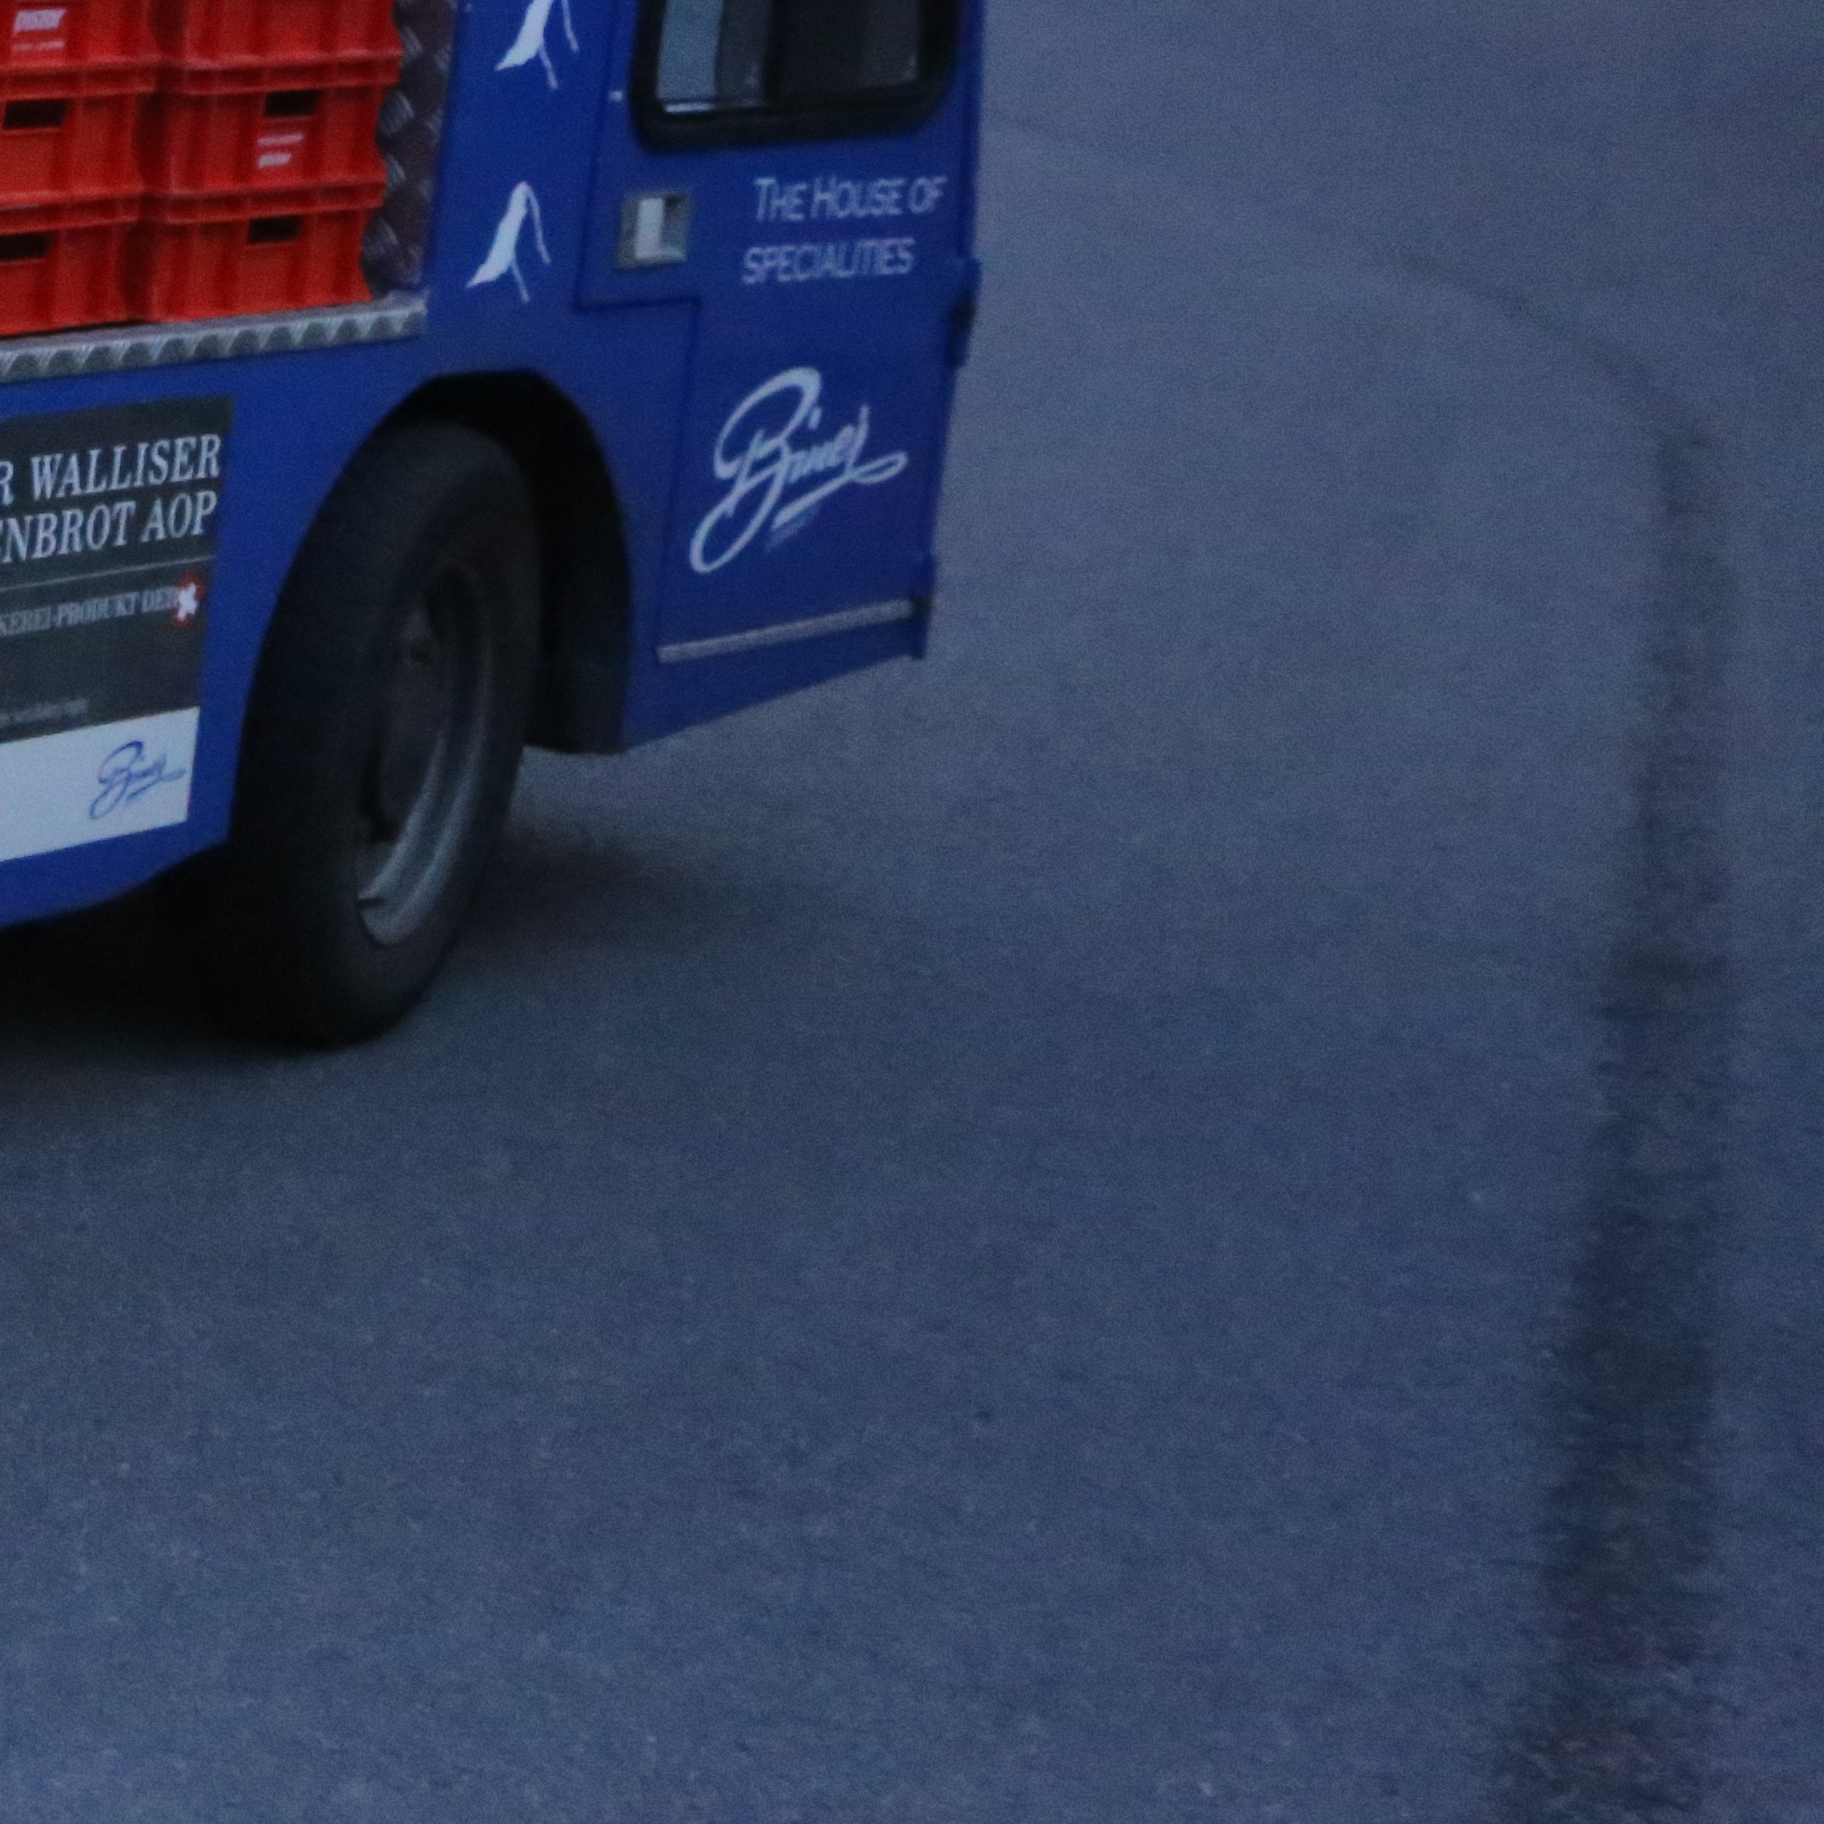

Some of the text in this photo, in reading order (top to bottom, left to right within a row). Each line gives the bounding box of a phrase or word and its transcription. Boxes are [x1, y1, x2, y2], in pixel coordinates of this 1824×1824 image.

[754, 174, 949, 222] THE HOUSE OF
[29, 433, 222, 503] WALLISER
[140, 489, 218, 543] AOP
